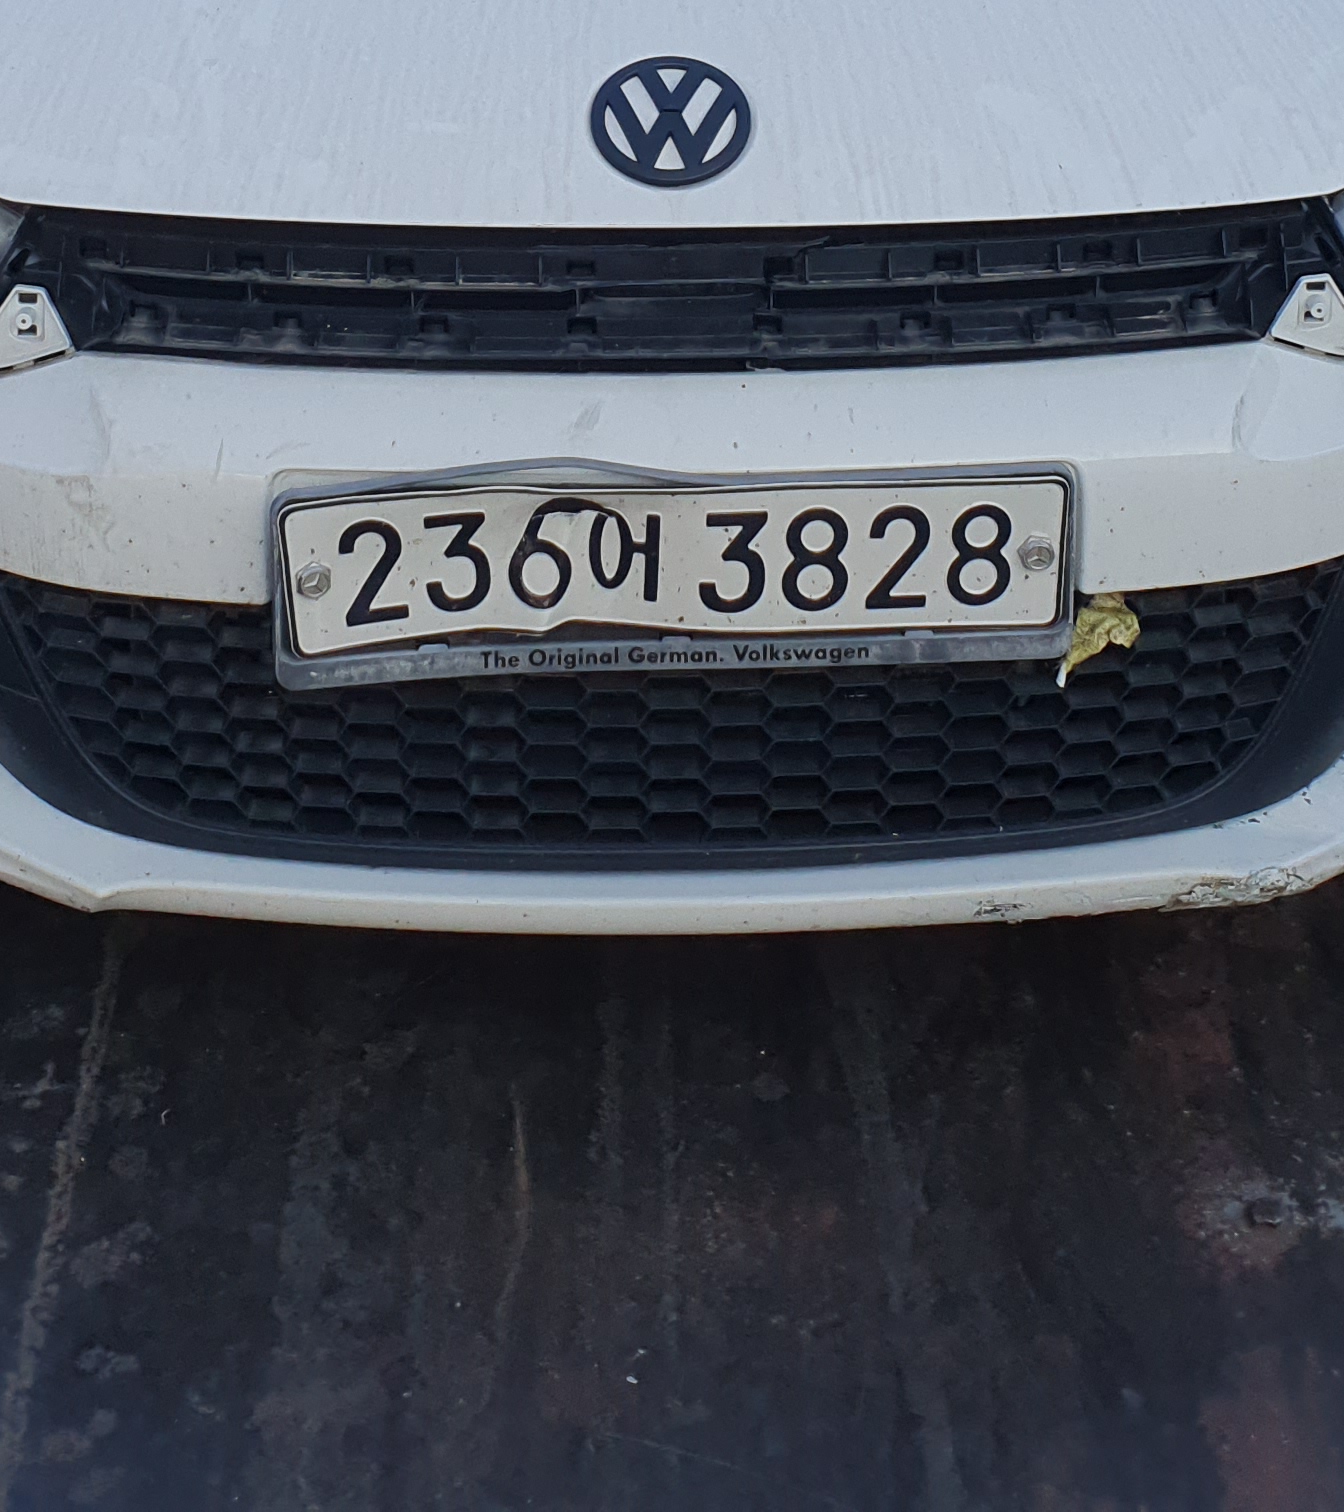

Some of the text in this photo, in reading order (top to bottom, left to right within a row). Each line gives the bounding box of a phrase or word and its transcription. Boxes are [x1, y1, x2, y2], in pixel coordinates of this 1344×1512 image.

[591, 56, 751, 187] VW
[338, 496, 1012, 627] 236어 3828
[481, 644, 870, 670] The Original German. Volkswagen
